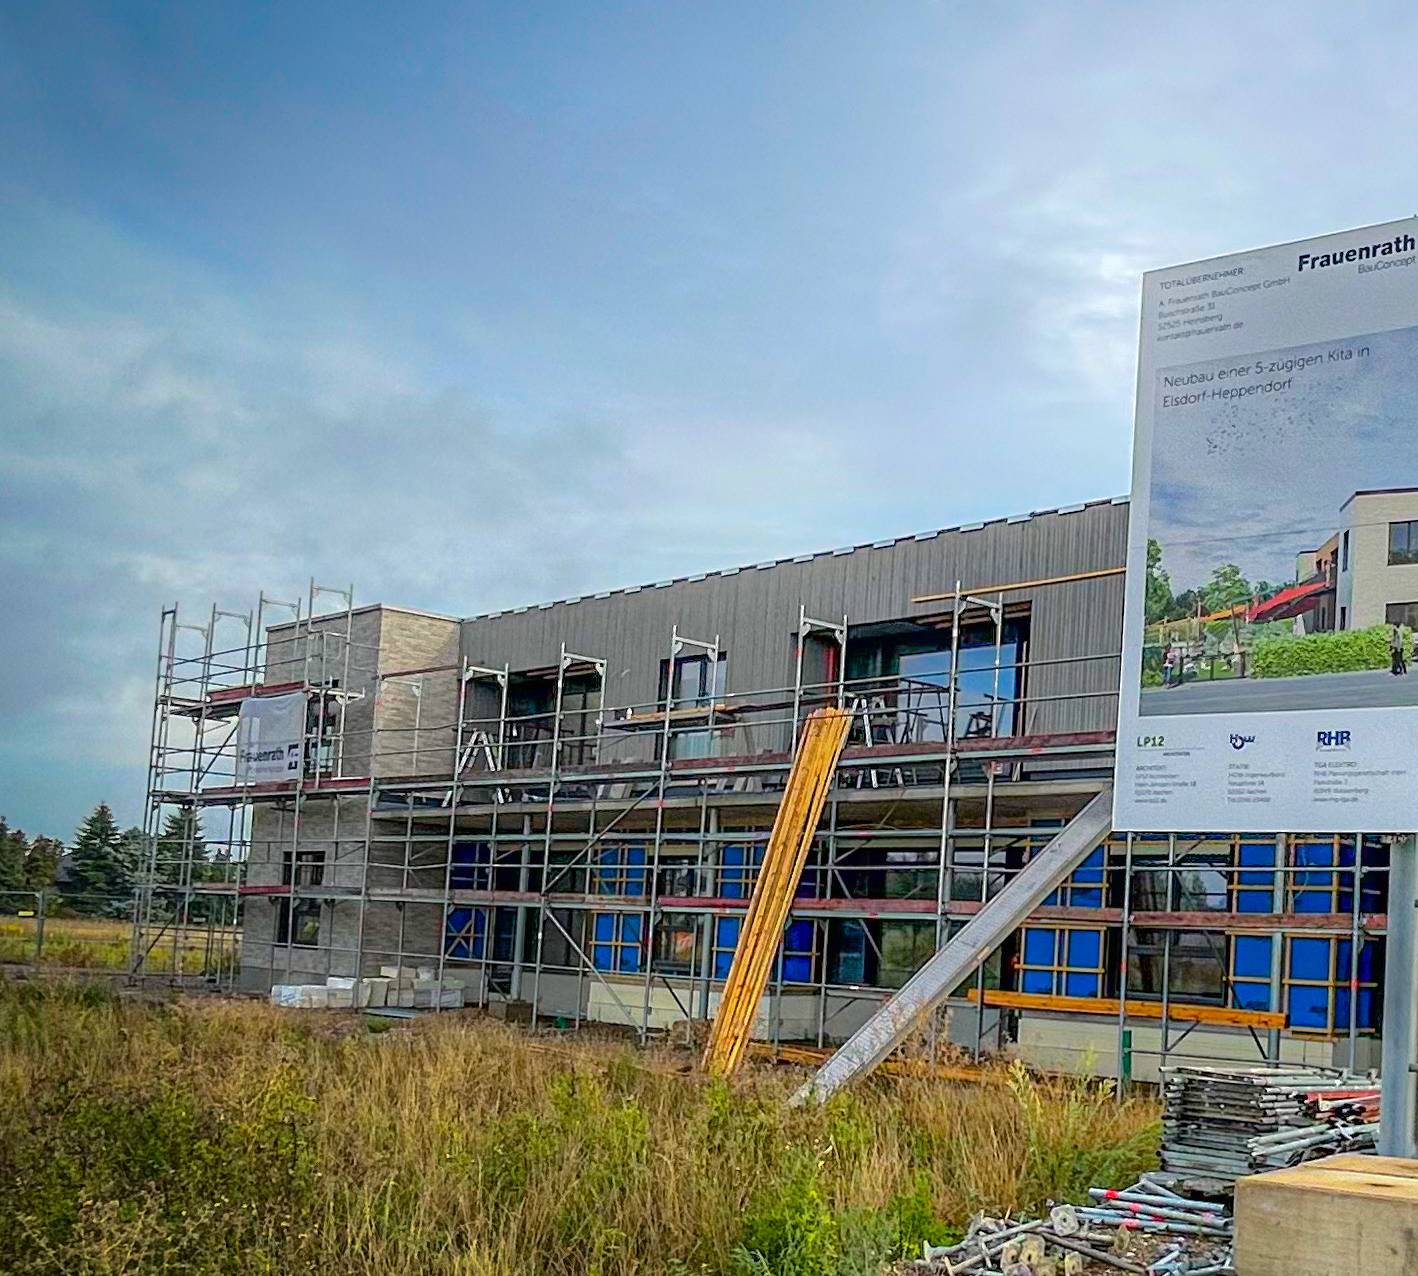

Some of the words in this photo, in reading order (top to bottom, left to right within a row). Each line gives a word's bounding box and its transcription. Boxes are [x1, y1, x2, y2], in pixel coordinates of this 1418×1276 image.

[1298, 235, 1415, 271] Frauenrath
[1358, 256, 1416, 274] BauConcept
[1263, 277, 1290, 288] GmbH
[1164, 372, 1215, 388] Neubau
[1218, 365, 1251, 380] einer
[1255, 353, 1323, 375] 5-zügigen
[1327, 349, 1353, 363] Kita
[1357, 346, 1370, 358] in
[1163, 377, 1293, 408] Elsdorf-Heppendorf
[1137, 735, 1165, 747] LP12
